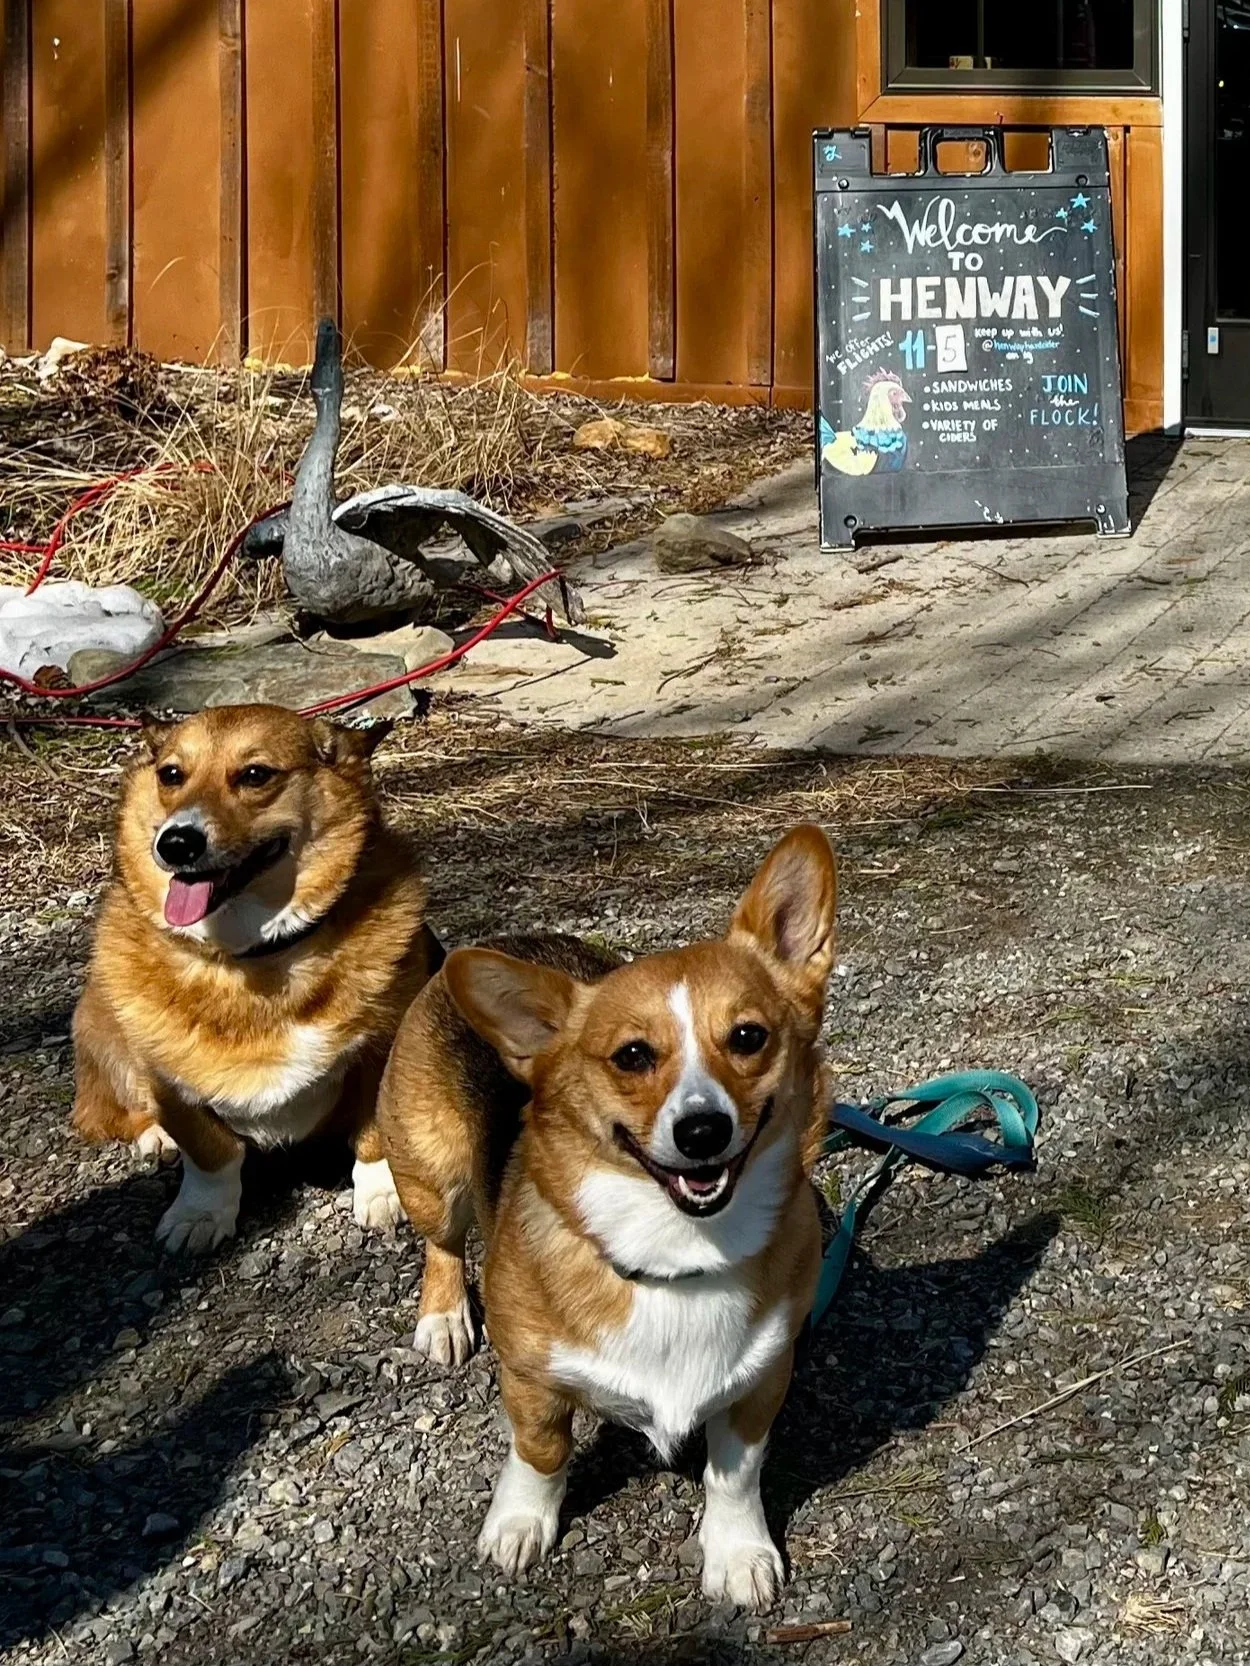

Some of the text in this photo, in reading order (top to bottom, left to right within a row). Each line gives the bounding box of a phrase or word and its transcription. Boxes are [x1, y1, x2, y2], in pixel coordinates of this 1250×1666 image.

[876, 195, 1067, 254] Welcome
[947, 251, 983, 271] TO
[879, 275, 1071, 321] HENWAY
[1019, 326, 1043, 337] with
[932, 379, 1013, 394] SANDWICHES
[1042, 373, 1088, 394] JOIN
[931, 399, 1002, 412] KIDS MEALS
[1050, 395, 1080, 408] the
[1030, 403, 1099, 426] FLOCK!
[930, 419, 999, 432] VARIETY OF
[939, 432, 976, 443] CIDERS
